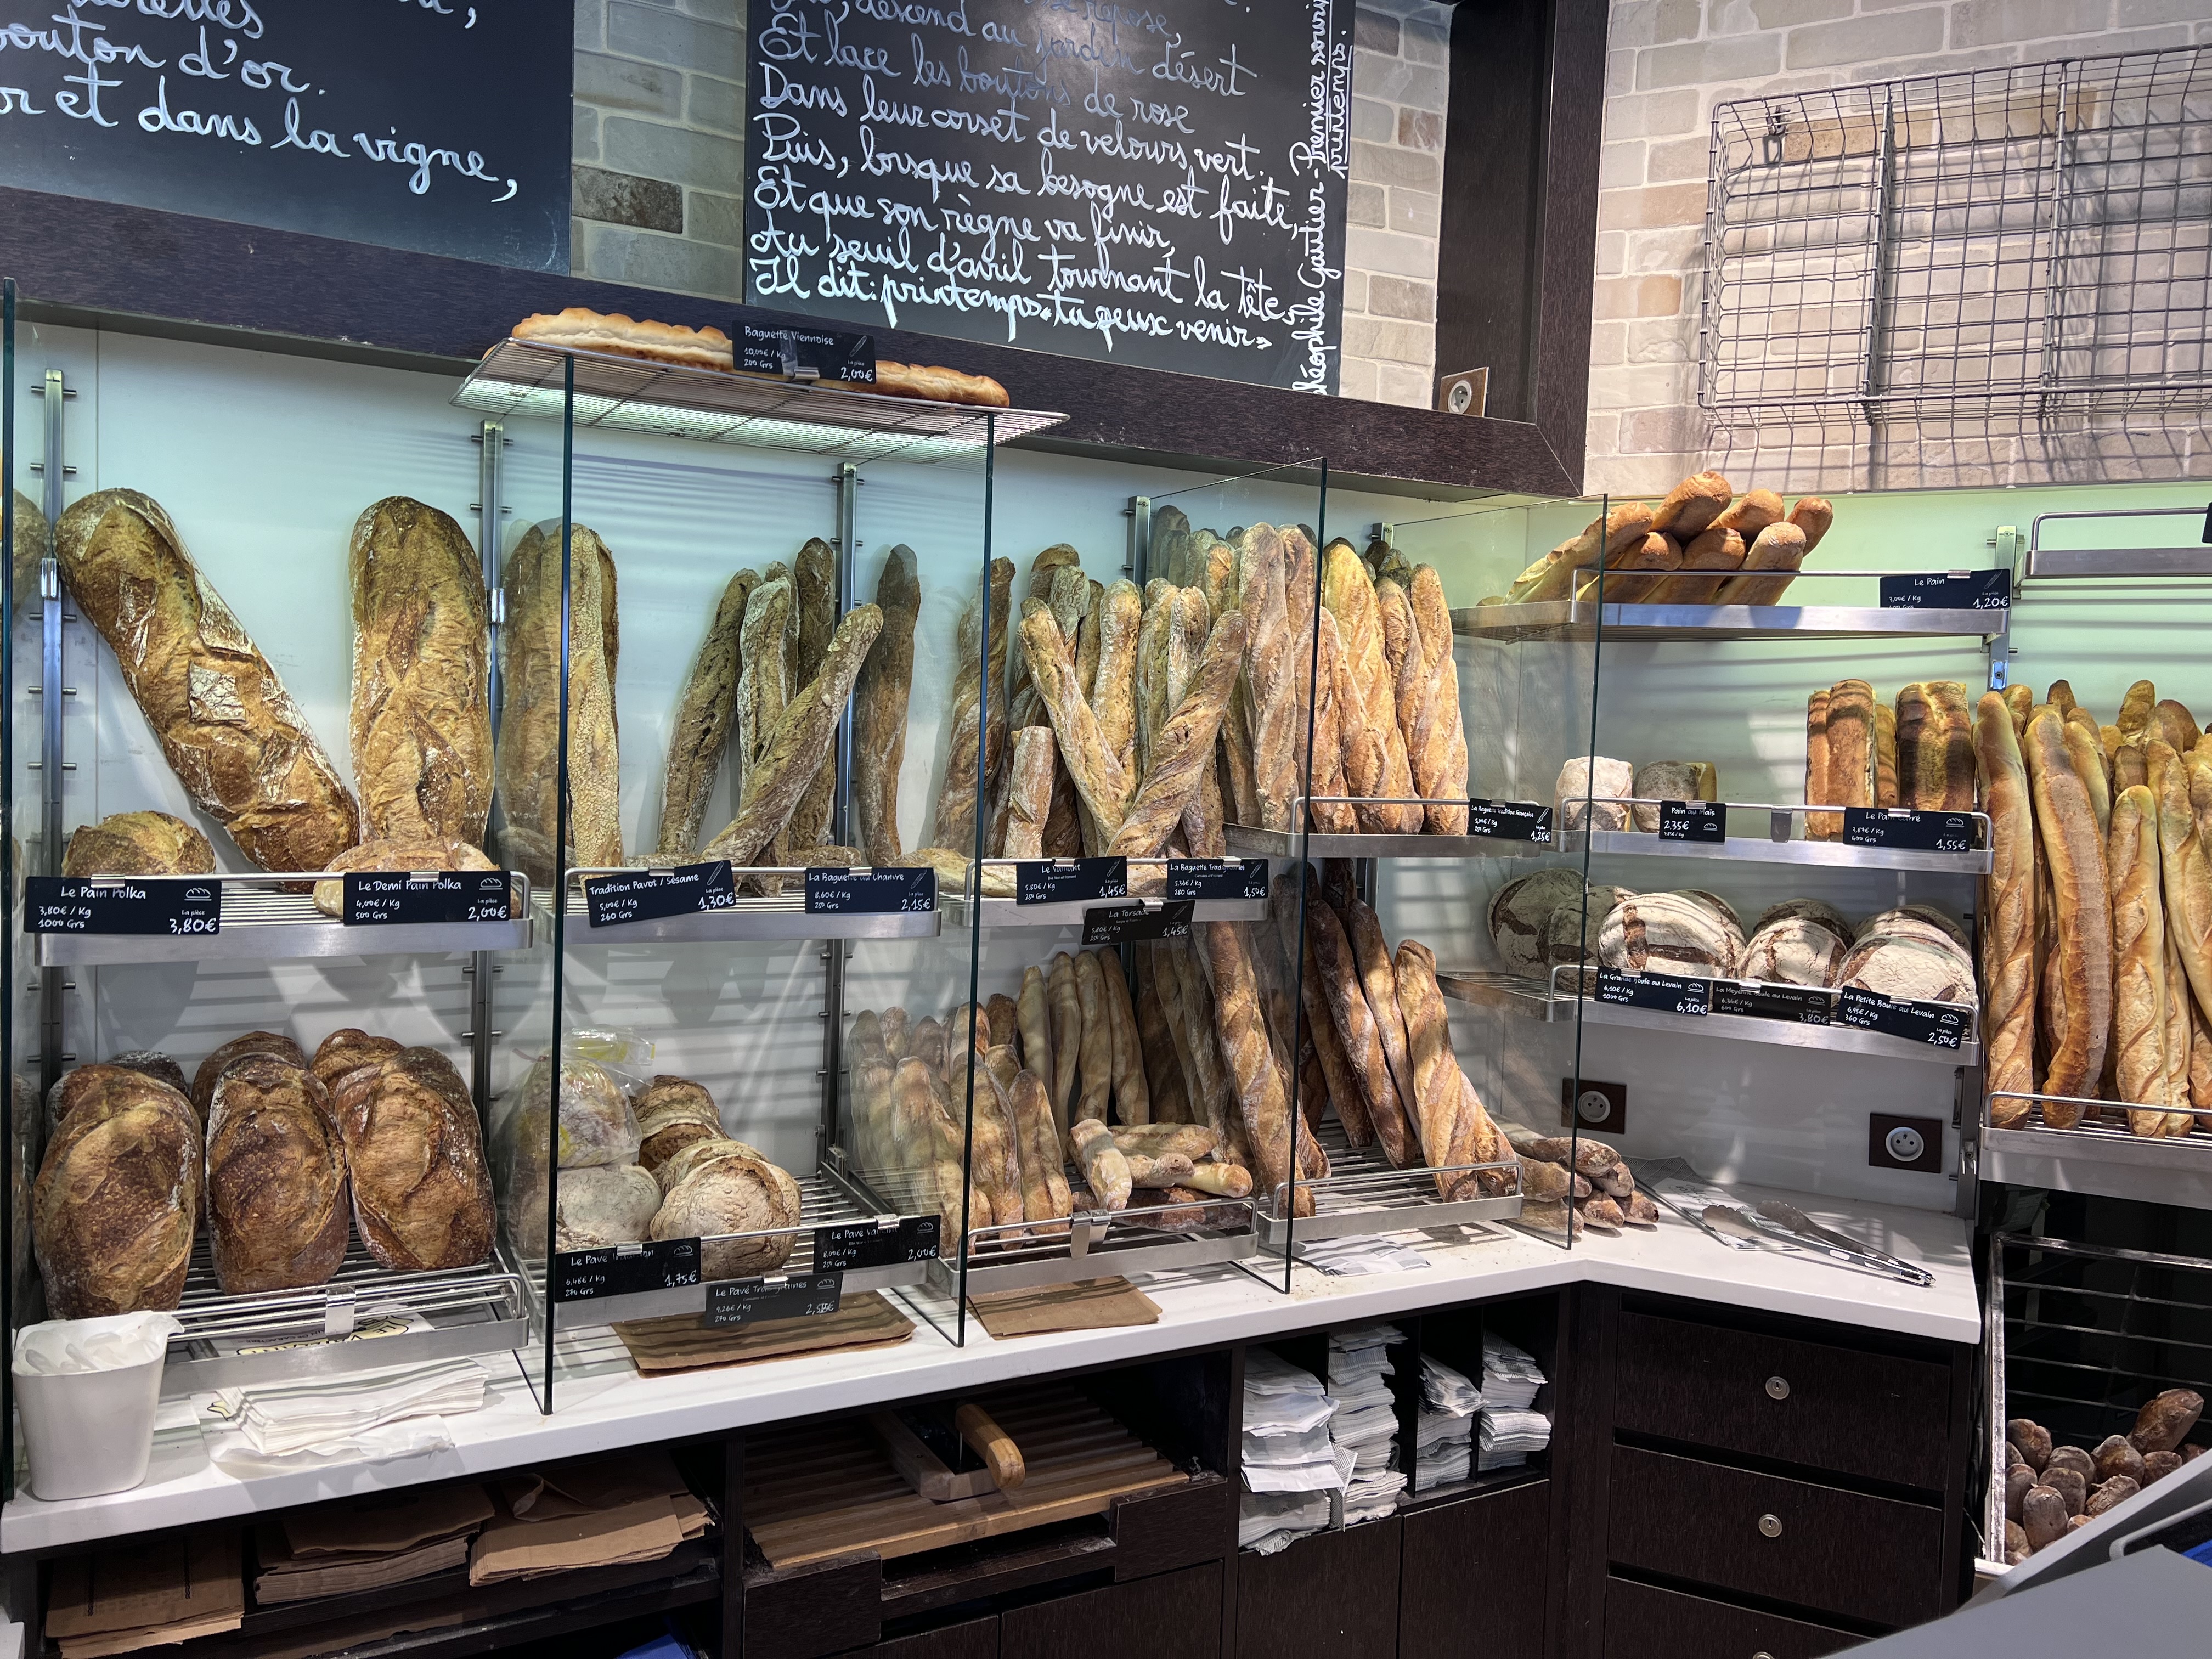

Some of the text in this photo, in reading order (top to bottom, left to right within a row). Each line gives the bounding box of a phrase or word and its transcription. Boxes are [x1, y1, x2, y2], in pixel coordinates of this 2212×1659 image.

[179, 25, 326, 95] d'or.
[982, 22, 1258, 97] au désert
[759, 10, 821, 64] Et
[823, 9, 901, 77] lace
[911, 33, 951, 88] les
[1084, 68, 1124, 118] de
[1130, 97, 1195, 133] rose
[759, 61, 1265, 180] Dans leur corset de velours vert.
[55, 60, 123, 127] et
[138, 76, 262, 145] dans
[270, 98, 350, 157] la
[353, 127, 518, 203] vigne,
[753, 112, 1297, 245] Puis, lorsque sa besogne est faite,
[1290, 70, 1342, 289] Gautier Premier
[754, 164, 1086, 262] Et que son règne va
[829, 224, 1230, 311] seuil d'avril tournant la
[879, 272, 1042, 342] printemps
[1095, 305, 1174, 353] peux
[744, 326, 834, 345] Baguette Viennoise
[776, 351, 786, 360] Kg
[759, 360, 773, 369] Grs
[840, 367, 873, 382] 2,00€
[1973, 596, 2008, 609] 1,20€
[1531, 831, 1550, 842] 1,25€
[1936, 839, 1966, 850] 1,55€
[1042, 865, 1050, 873] Le
[1181, 864, 1207, 873] Baguette
[809, 872, 819, 881] La
[359, 878, 461, 891] Le Demi Pain Polka
[589, 879, 657, 895] Tradition Pavot
[1048, 882, 1055, 891] Kg
[1099, 884, 1125, 898] 1,45€
[61, 886, 146, 899] Le Pain Polka
[842, 892, 850, 901] Kg
[1244, 886, 1265, 899] 1,50€
[356, 899, 400, 910] 4,00€ Kg
[628, 899, 637, 908] Kg
[698, 892, 734, 911] 1,30€
[901, 898, 930, 912] 2,15€
[39, 906, 91, 918] 3,80€ Kg
[356, 911, 387, 920] 500 Grs
[467, 905, 507, 921] 2,00€
[600, 911, 633, 922] 260 Grs
[38, 919, 84, 928] 1000 Grs
[169, 917, 217, 935] 3,80€
[1162, 924, 1188, 938] 1,45€
[1662, 981, 1682, 989] Levain
[1626, 988, 1634, 996] Kg
[1782, 993, 1802, 1001] Levain
[1676, 1001, 1707, 1014] 6,10€
[1844, 992, 1854, 1000] La
[1855, 995, 1875, 1006] Petite
[1877, 1000, 1897, 1010] Boule
[1911, 1007, 1934, 1019] Levain
[1798, 1013, 1829, 1024] 3,80€
[1845, 1014, 1870, 1026] 360 Grs
[1870, 1012, 1878, 1020] Kg
[1927, 1032, 1957, 1047] 2,50€
[832, 1231, 841, 1240] Le
[848, 1248, 856, 1257] Kg
[907, 1245, 936, 1261] 2,00€
[571, 1257, 582, 1266] Le
[566, 1275, 605, 1286] 6,48€ Kg
[664, 1270, 697, 1288] 1,75€
[715, 1285, 749, 1297] Le Pavé
[743, 1304, 751, 1312] Kg
